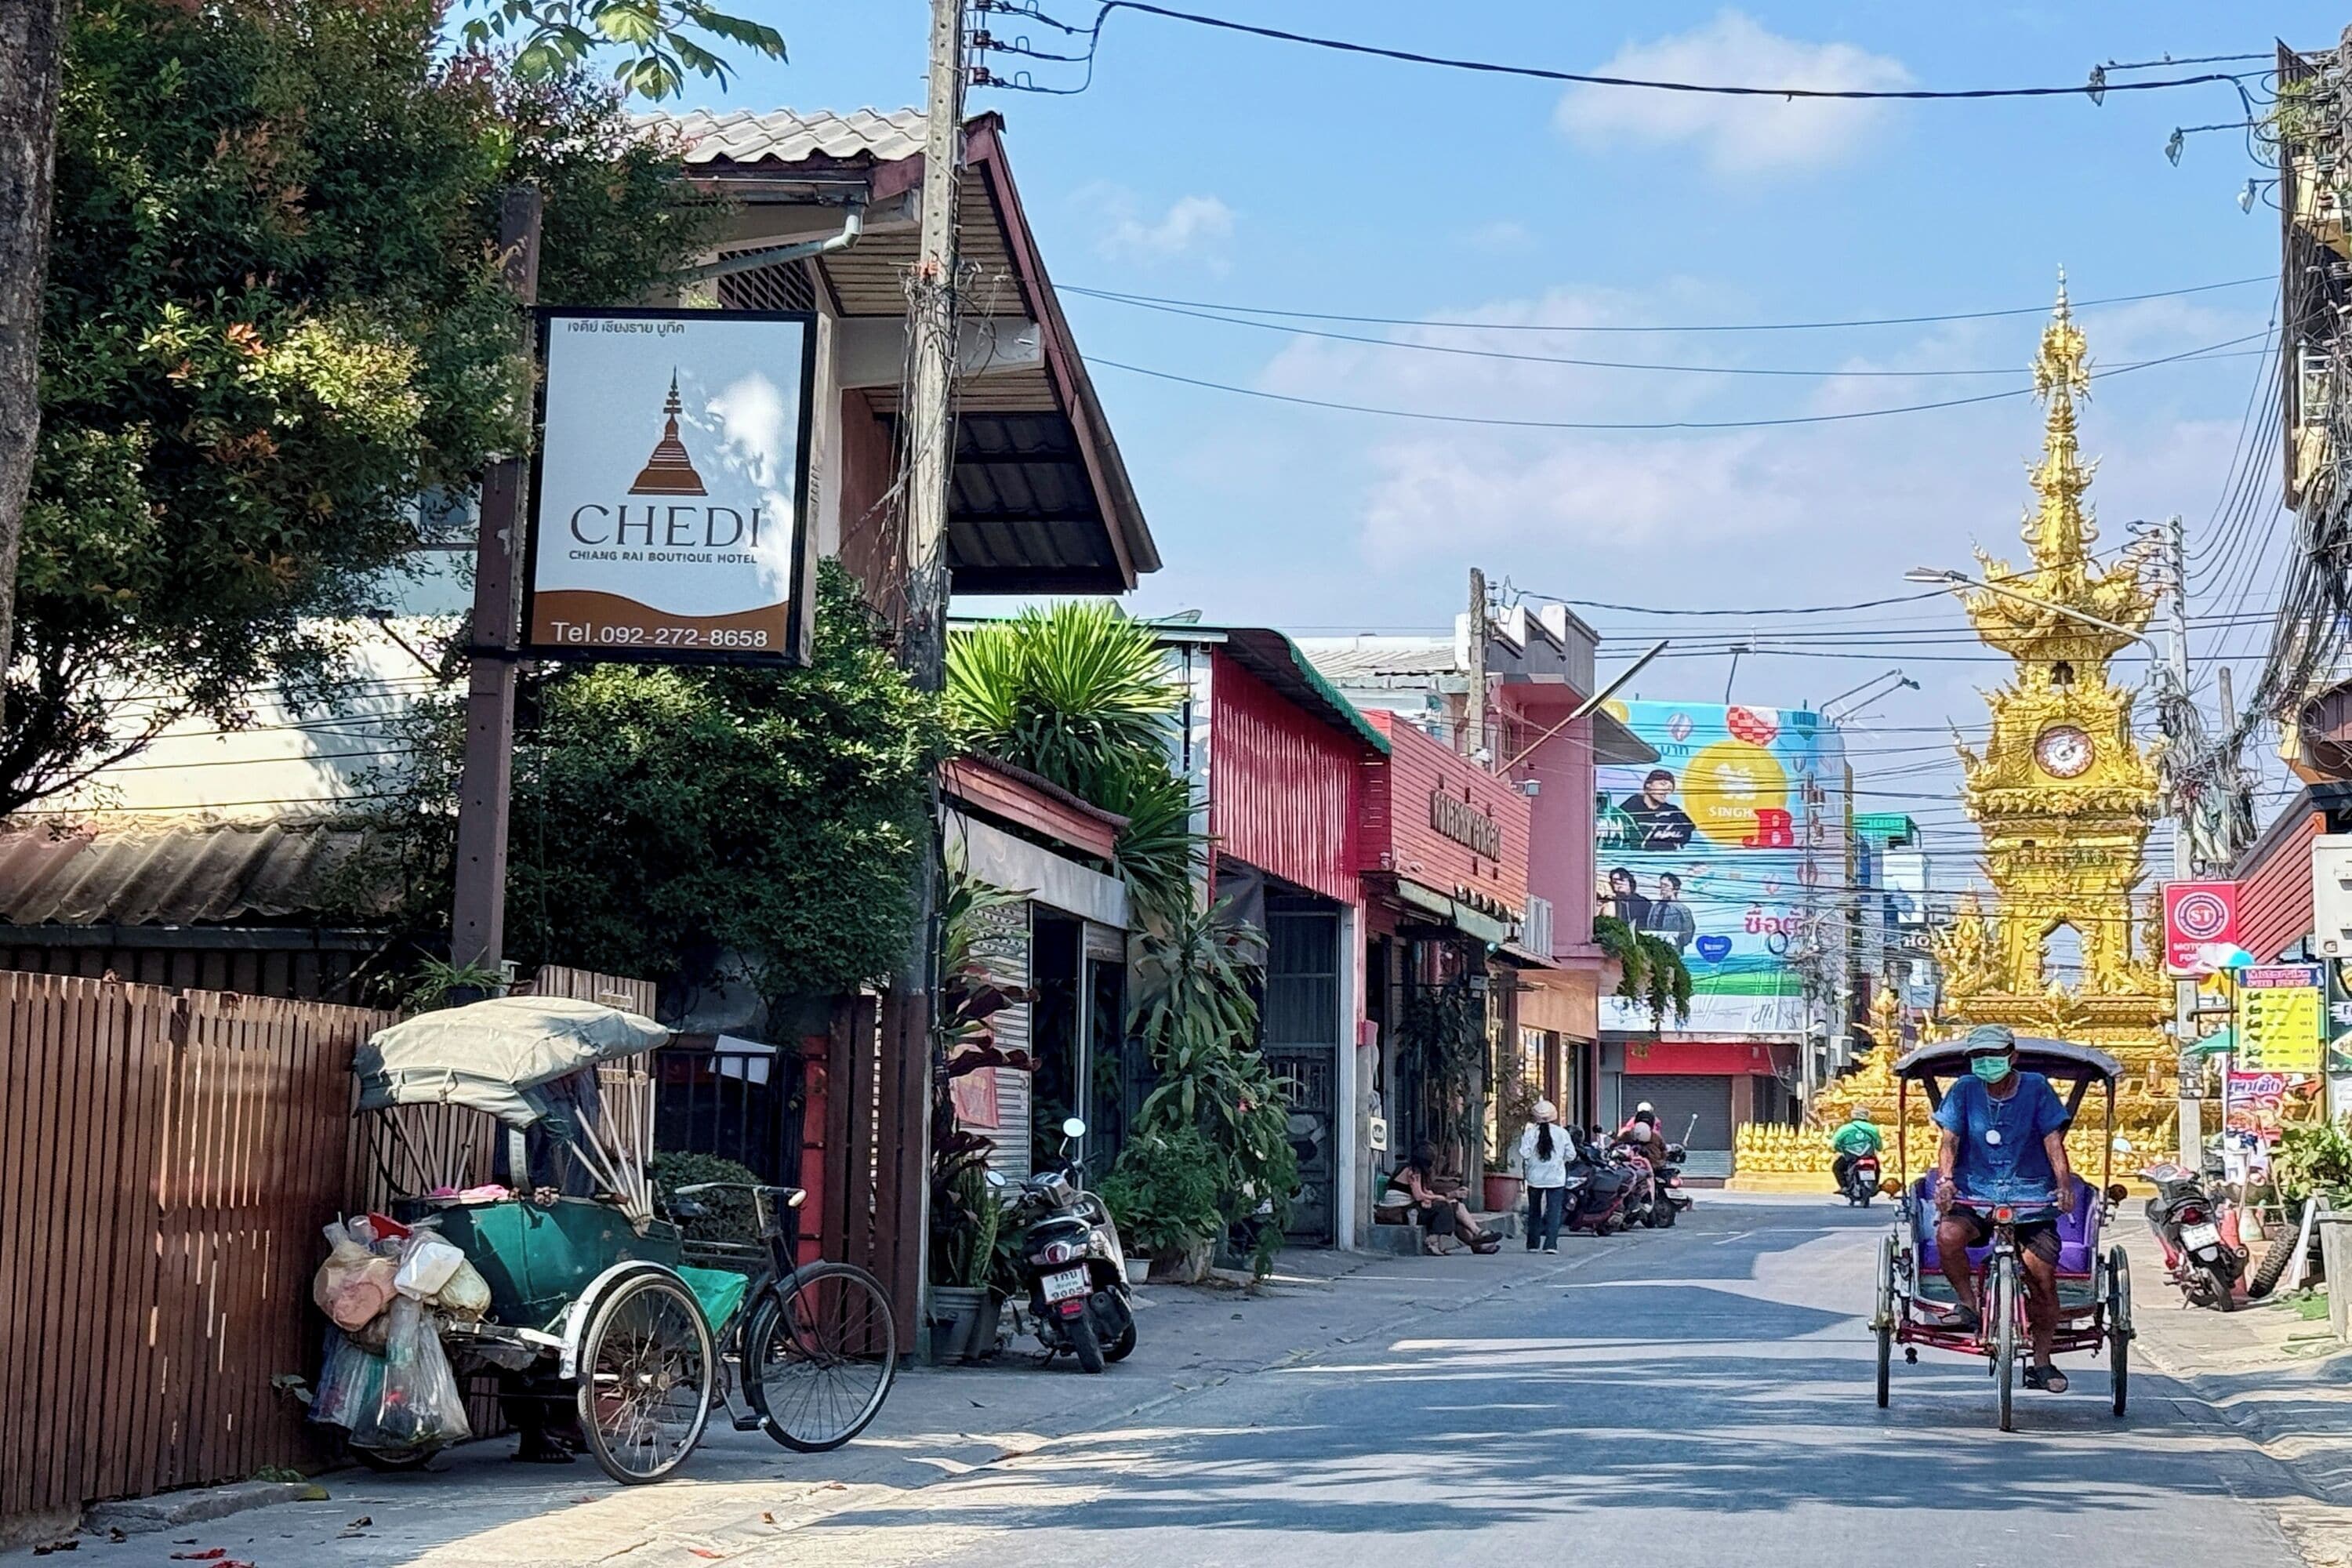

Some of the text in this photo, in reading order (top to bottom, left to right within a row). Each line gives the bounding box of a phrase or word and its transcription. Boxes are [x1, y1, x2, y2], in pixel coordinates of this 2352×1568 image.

[601, 320, 653, 333] เชียงราย
[571, 503, 762, 548] CHEDI
[568, 550, 758, 564] CHIANG RAI BOUTIQUE HOTEL
[550, 622, 768, 648] Tel.092-272-8658
[1708, 806, 1755, 818] SINGH
[2190, 909, 2213, 924] ST
